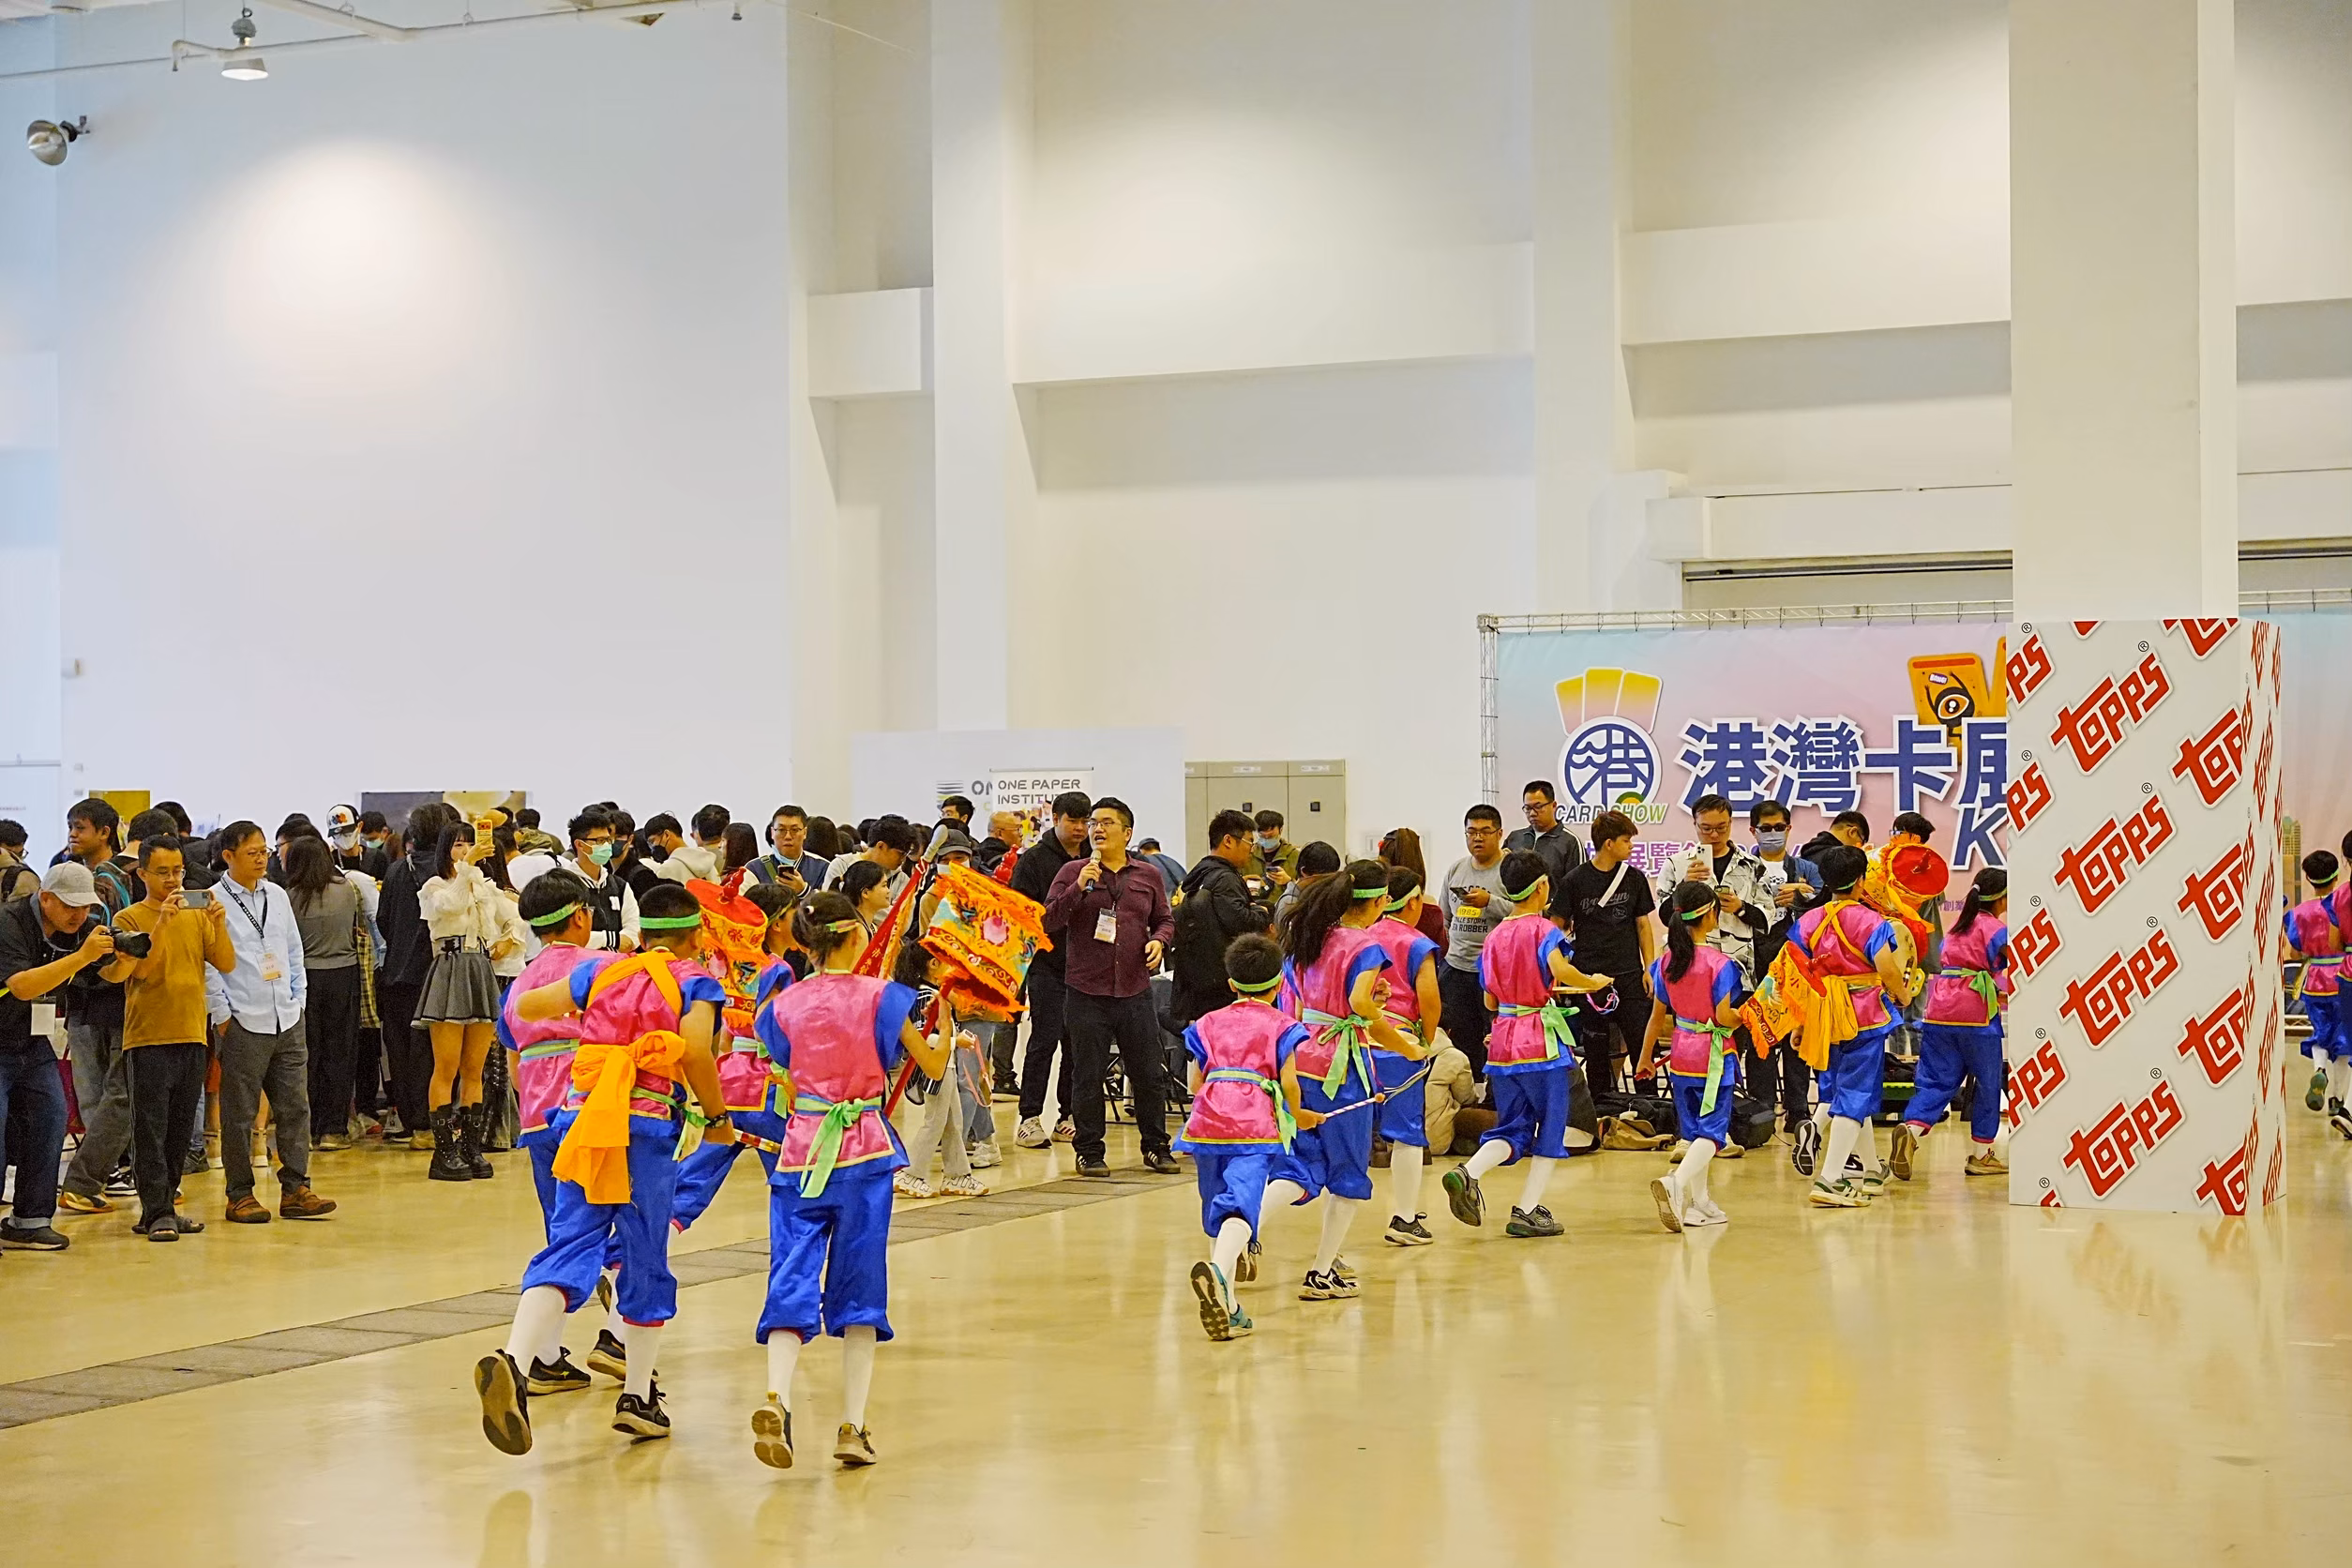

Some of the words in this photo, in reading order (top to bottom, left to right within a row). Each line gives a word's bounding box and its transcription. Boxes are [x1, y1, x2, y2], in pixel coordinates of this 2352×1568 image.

[998, 779, 1027, 790] ONE
[1032, 779, 1080, 790] PAPER
[998, 794, 1059, 805] INSTITU
[1611, 805, 1666, 822] HOW
